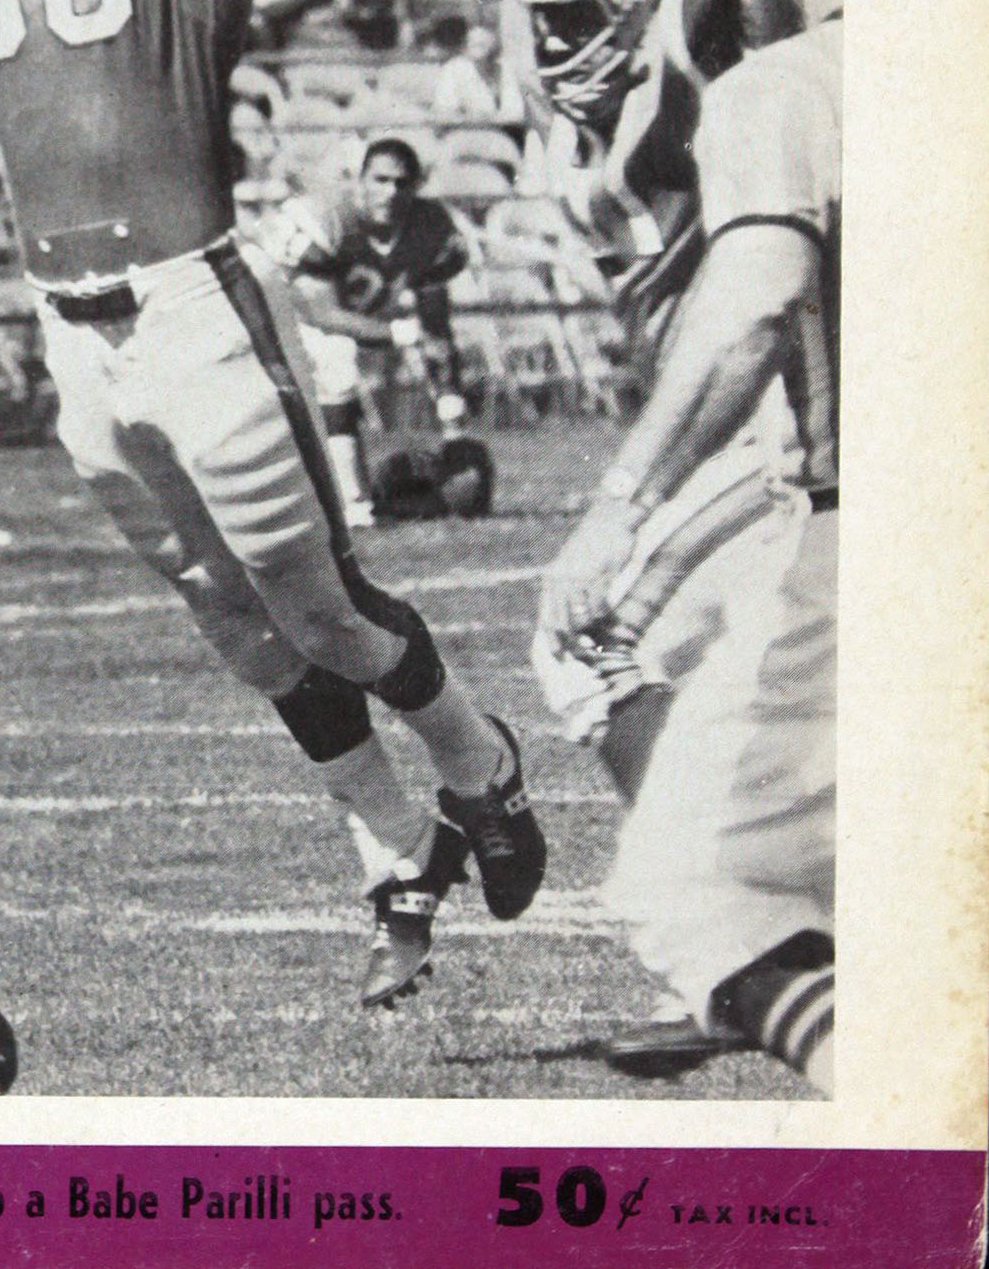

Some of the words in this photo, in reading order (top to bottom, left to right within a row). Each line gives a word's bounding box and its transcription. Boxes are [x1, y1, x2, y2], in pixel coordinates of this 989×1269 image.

[26, 1191, 44, 1217] a
[70, 1175, 158, 1219] Babe
[182, 1175, 290, 1219] Parilli
[315, 1193, 401, 1229] pass.
[671, 1206, 731, 1224] TAX
[748, 1205, 830, 1226] INCL.
